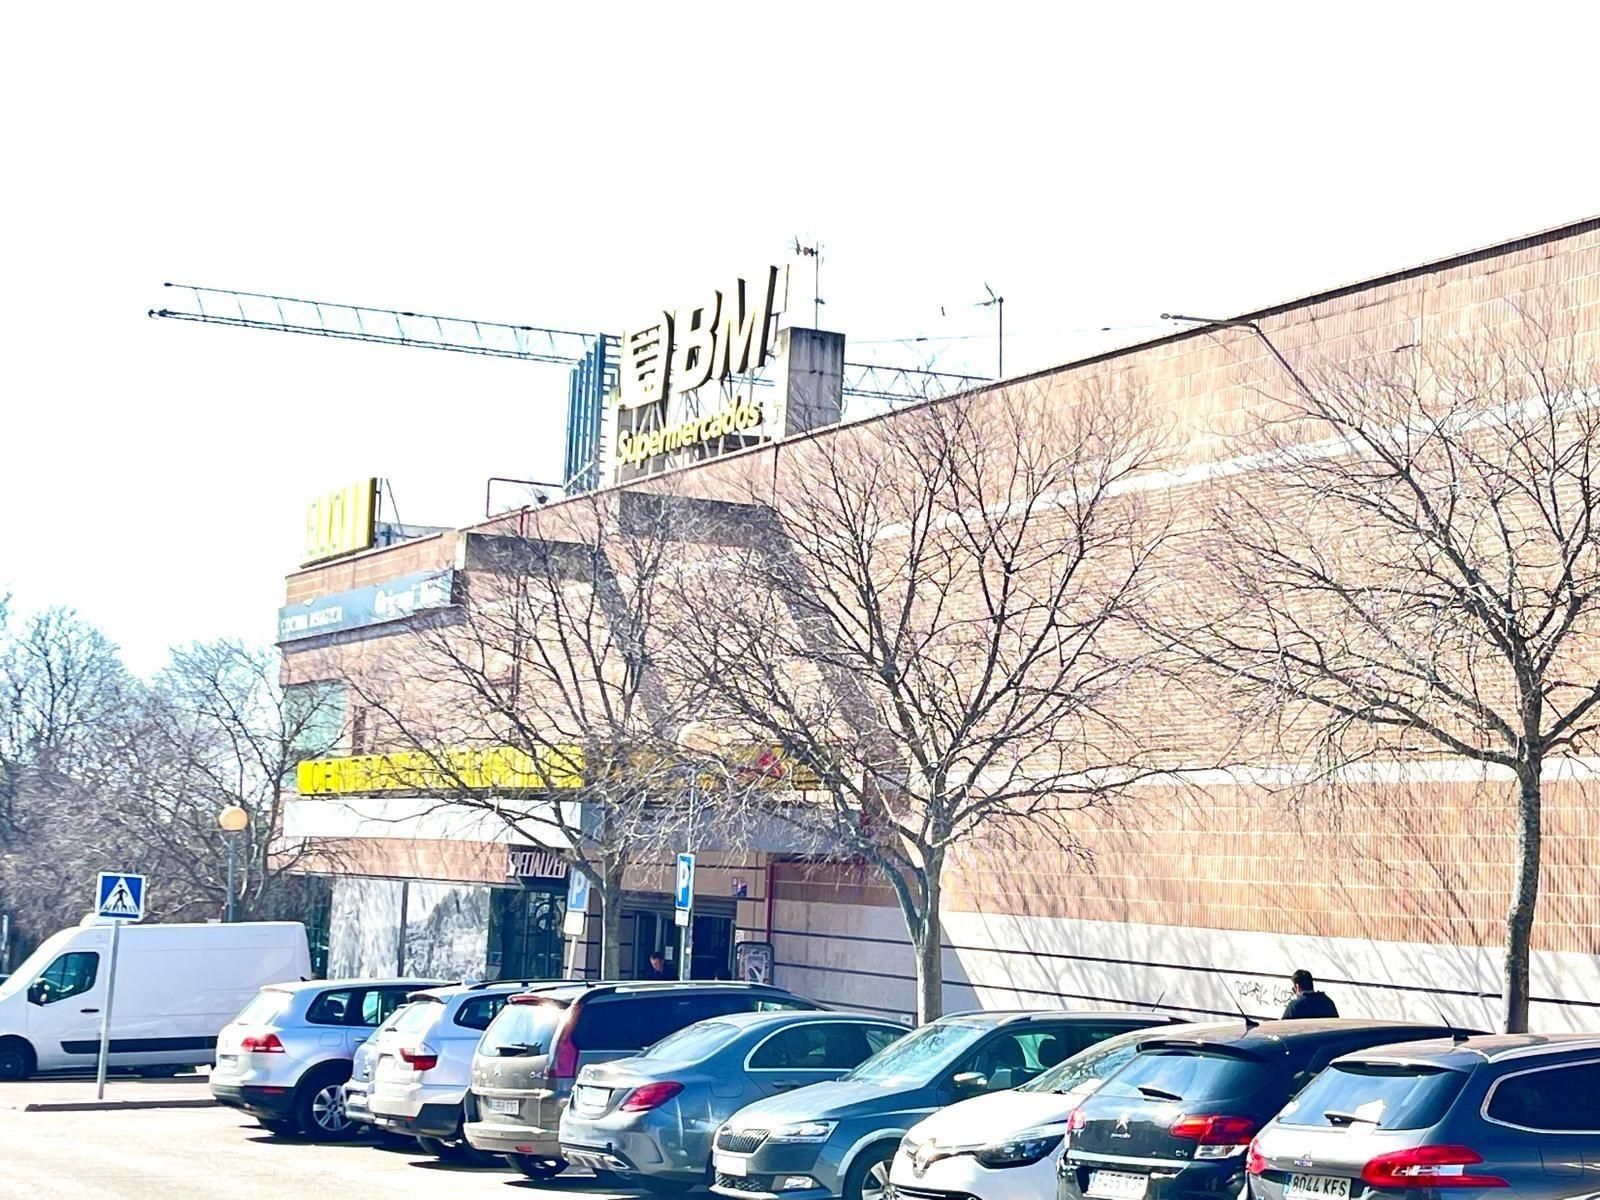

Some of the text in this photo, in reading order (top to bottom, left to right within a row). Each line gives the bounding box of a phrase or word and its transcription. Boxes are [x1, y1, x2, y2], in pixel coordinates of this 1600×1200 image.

[671, 264, 778, 393] BM
[617, 396, 764, 468] Supermercados
[677, 859, 690, 902] P
[1293, 1175, 1347, 1197] 8044 KFS
